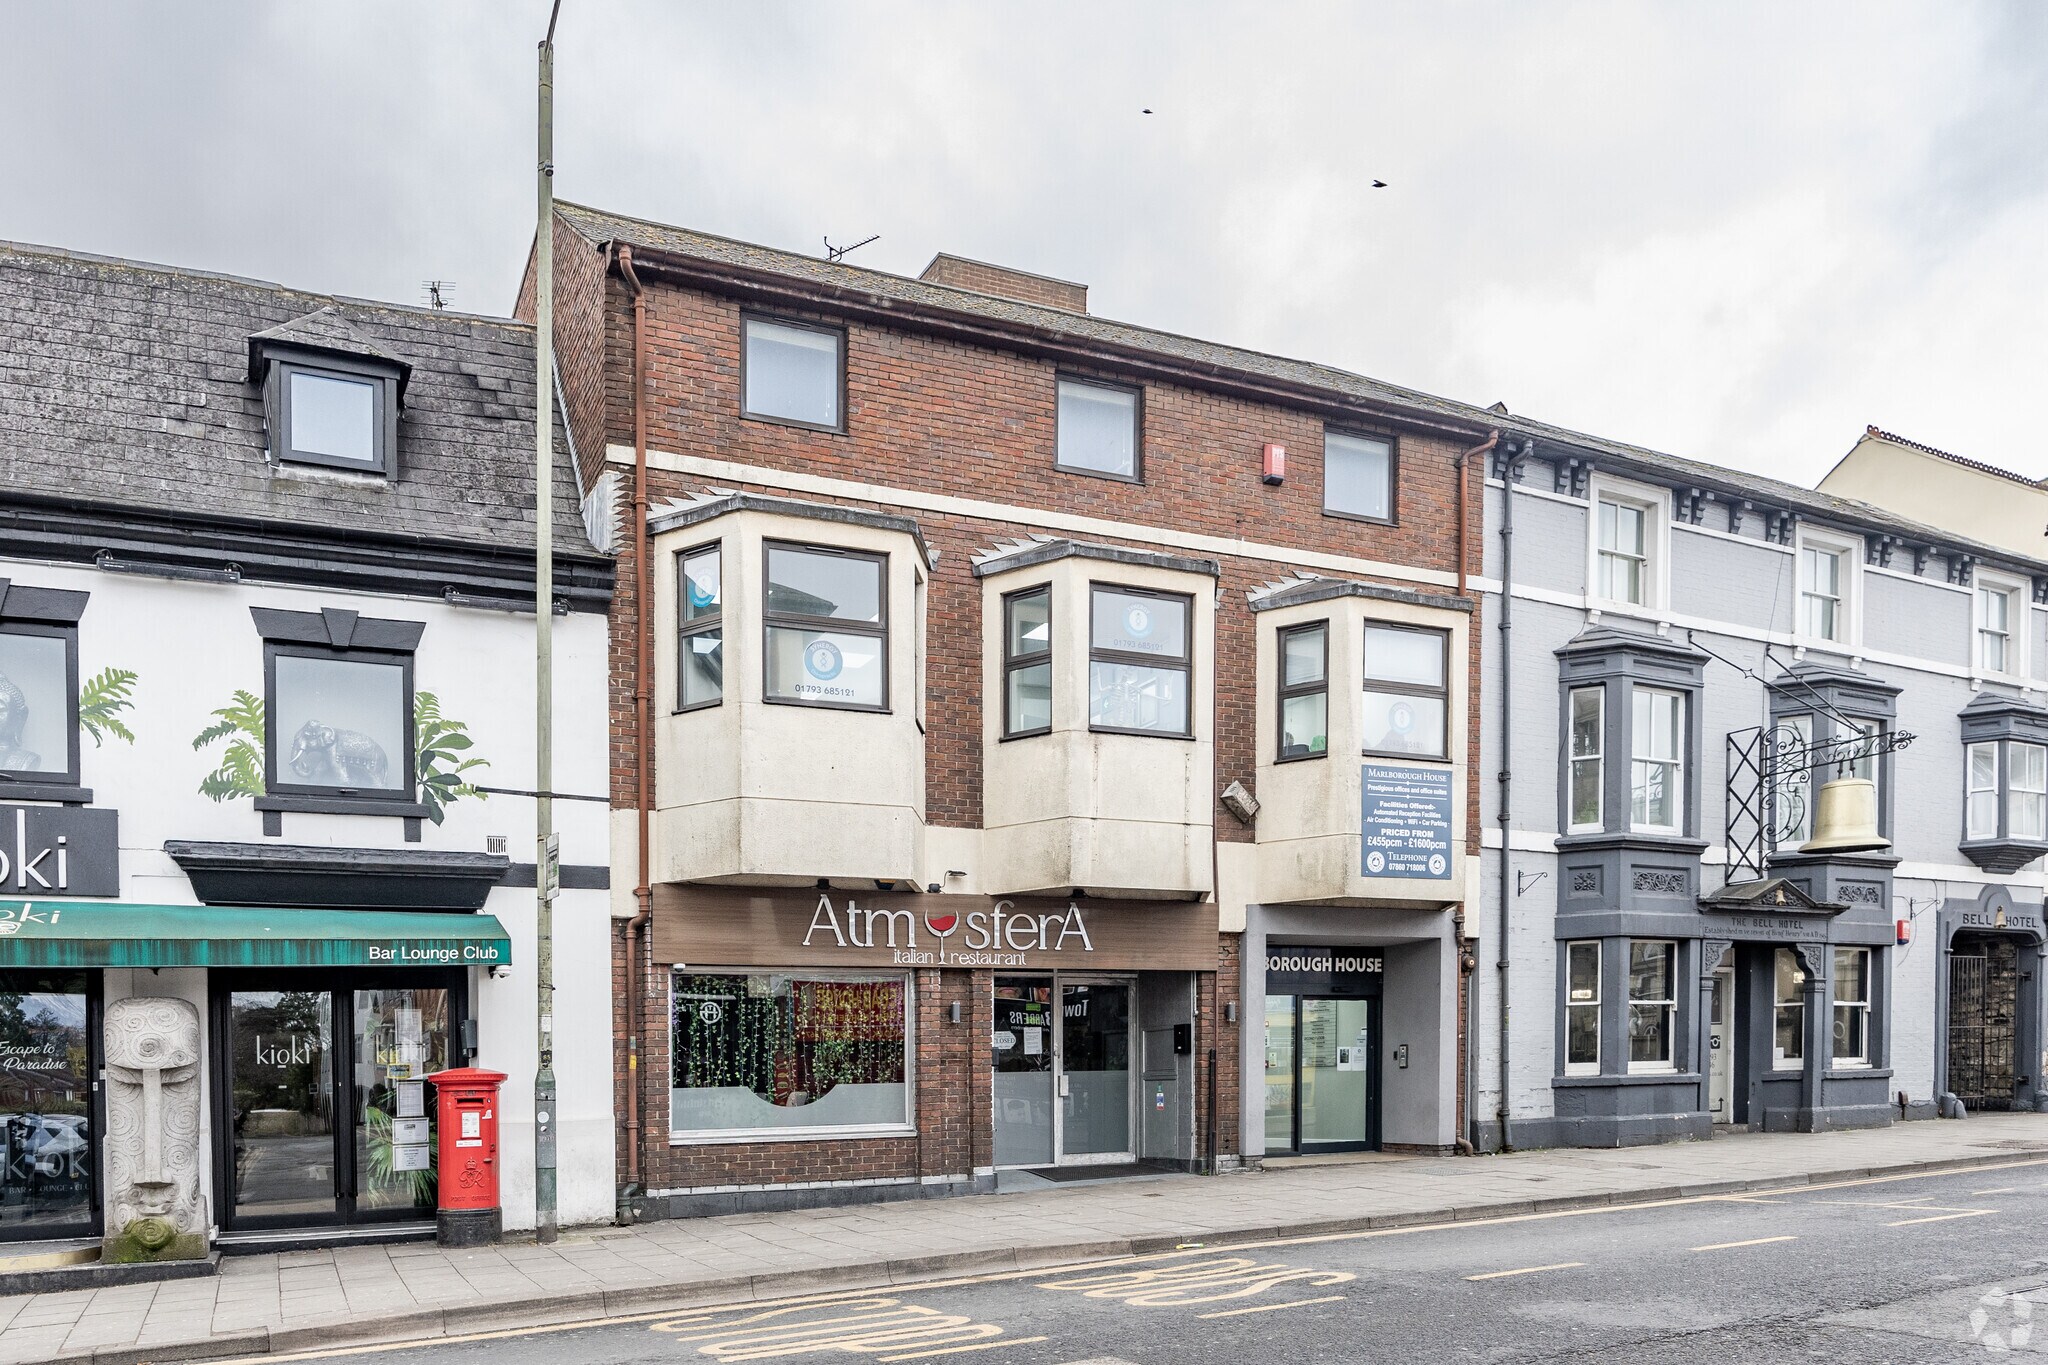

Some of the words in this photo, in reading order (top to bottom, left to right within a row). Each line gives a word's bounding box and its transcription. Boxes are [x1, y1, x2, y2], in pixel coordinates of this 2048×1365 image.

[795, 684, 822, 693] 01793
[824, 687, 855, 697] 685121
[1367, 784, 1394, 793] Prestigious
[1394, 785, 1410, 794] offices
[1410, 786, 1420, 794] and
[1420, 787, 1433, 795] office
[1379, 801, 1408, 809] Facilities
[1399, 810, 1421, 818] Reception
[1374, 817, 1404, 826] Conditioning
[1430, 820, 1448, 828] Parking
[1381, 828, 1410, 837] PRICED
[1411, 829, 1434, 838] FROM
[0, 809, 67, 888] ki
[1367, 836, 1403, 848] £455pcm
[1408, 837, 1447, 850] £1600pcm
[1388, 862, 1406, 871] 07860
[1731, 917, 1746, 927] THE
[1753, 918, 1773, 928] BELL
[1778, 919, 1803, 930] HOTEL
[1962, 913, 1992, 926] BELL
[369, 946, 396, 960] Bar
[401, 946, 459, 963] Lounge
[463, 945, 499, 960] Club
[893, 949, 934, 964] italian
[951, 951, 1027, 966] restaurant
[1335, 957, 1382, 973] HOUSE
[0, 1040, 40, 1056] Escape
[43, 1042, 56, 1055] to
[256, 1034, 310, 1066] kioki
[3, 1056, 68, 1072] Paradise
[9, 1187, 27, 1195] BAR
